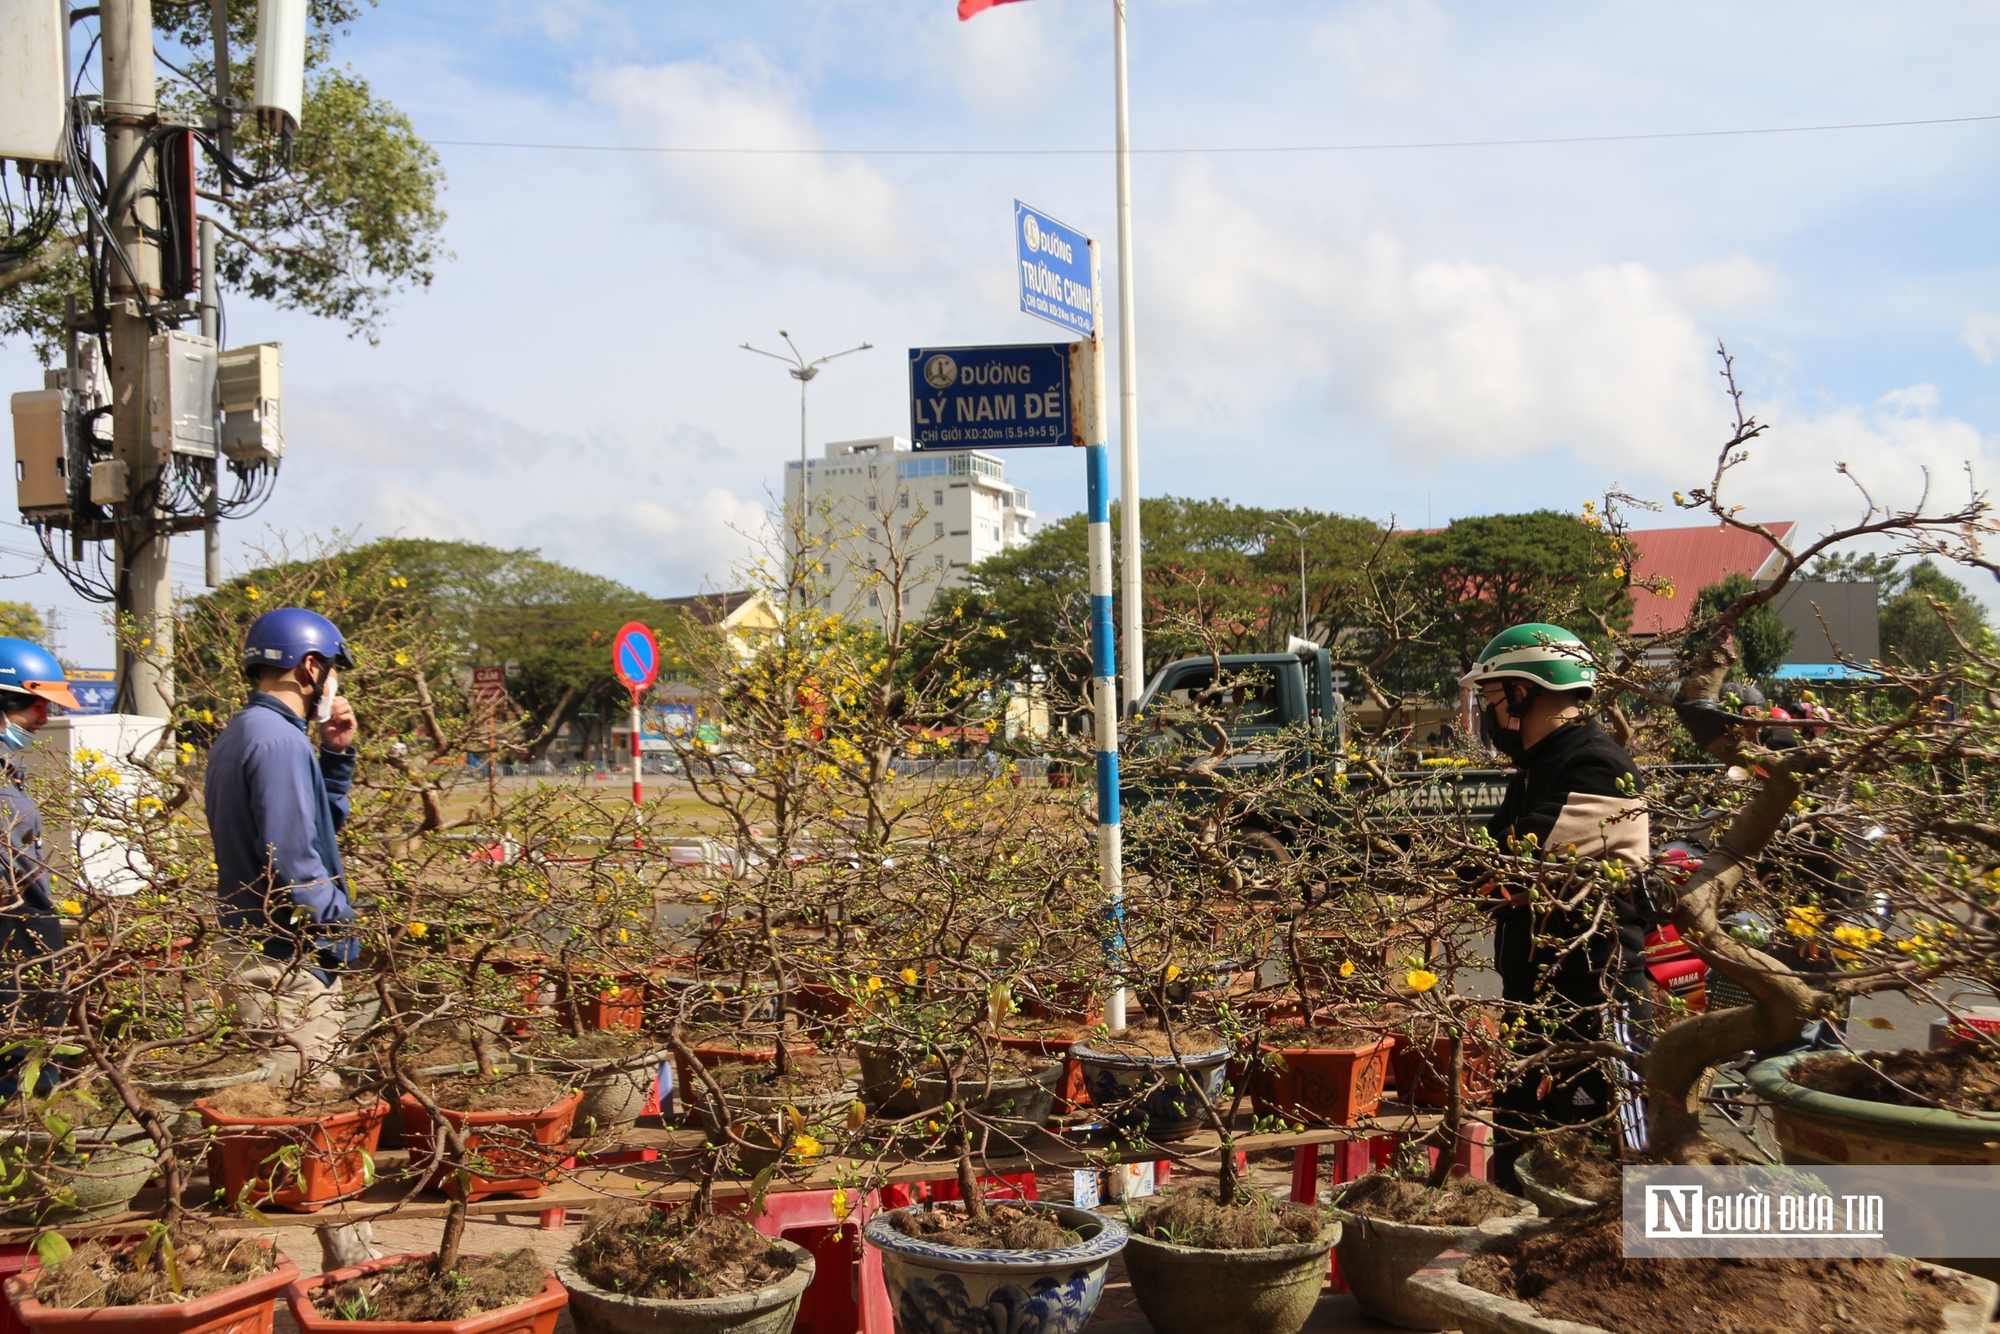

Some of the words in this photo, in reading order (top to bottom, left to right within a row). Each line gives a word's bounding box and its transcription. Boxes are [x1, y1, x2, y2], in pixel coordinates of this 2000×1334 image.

[1040, 231, 1073, 264] ĐƯỜNG
[1022, 260, 1062, 302] TRƯỜNG
[1063, 278, 1092, 314] CHINH
[960, 360, 1031, 385] ĐƯỜNG
[916, 391, 947, 424] LÝ
[956, 394, 1017, 422] NAM
[1024, 383, 1061, 418] ĐẾ
[921, 426, 938, 442] CHỈ
[940, 425, 962, 441] GIỚI
[964, 428, 1003, 440] XD:20m
[788, 459, 816, 469] Hoel
[0, 667, 17, 675] ank
[1414, 785, 1454, 808] CÂY
[1462, 781, 1507, 806] CẢN
[1668, 972, 1699, 987] YAMAHA
